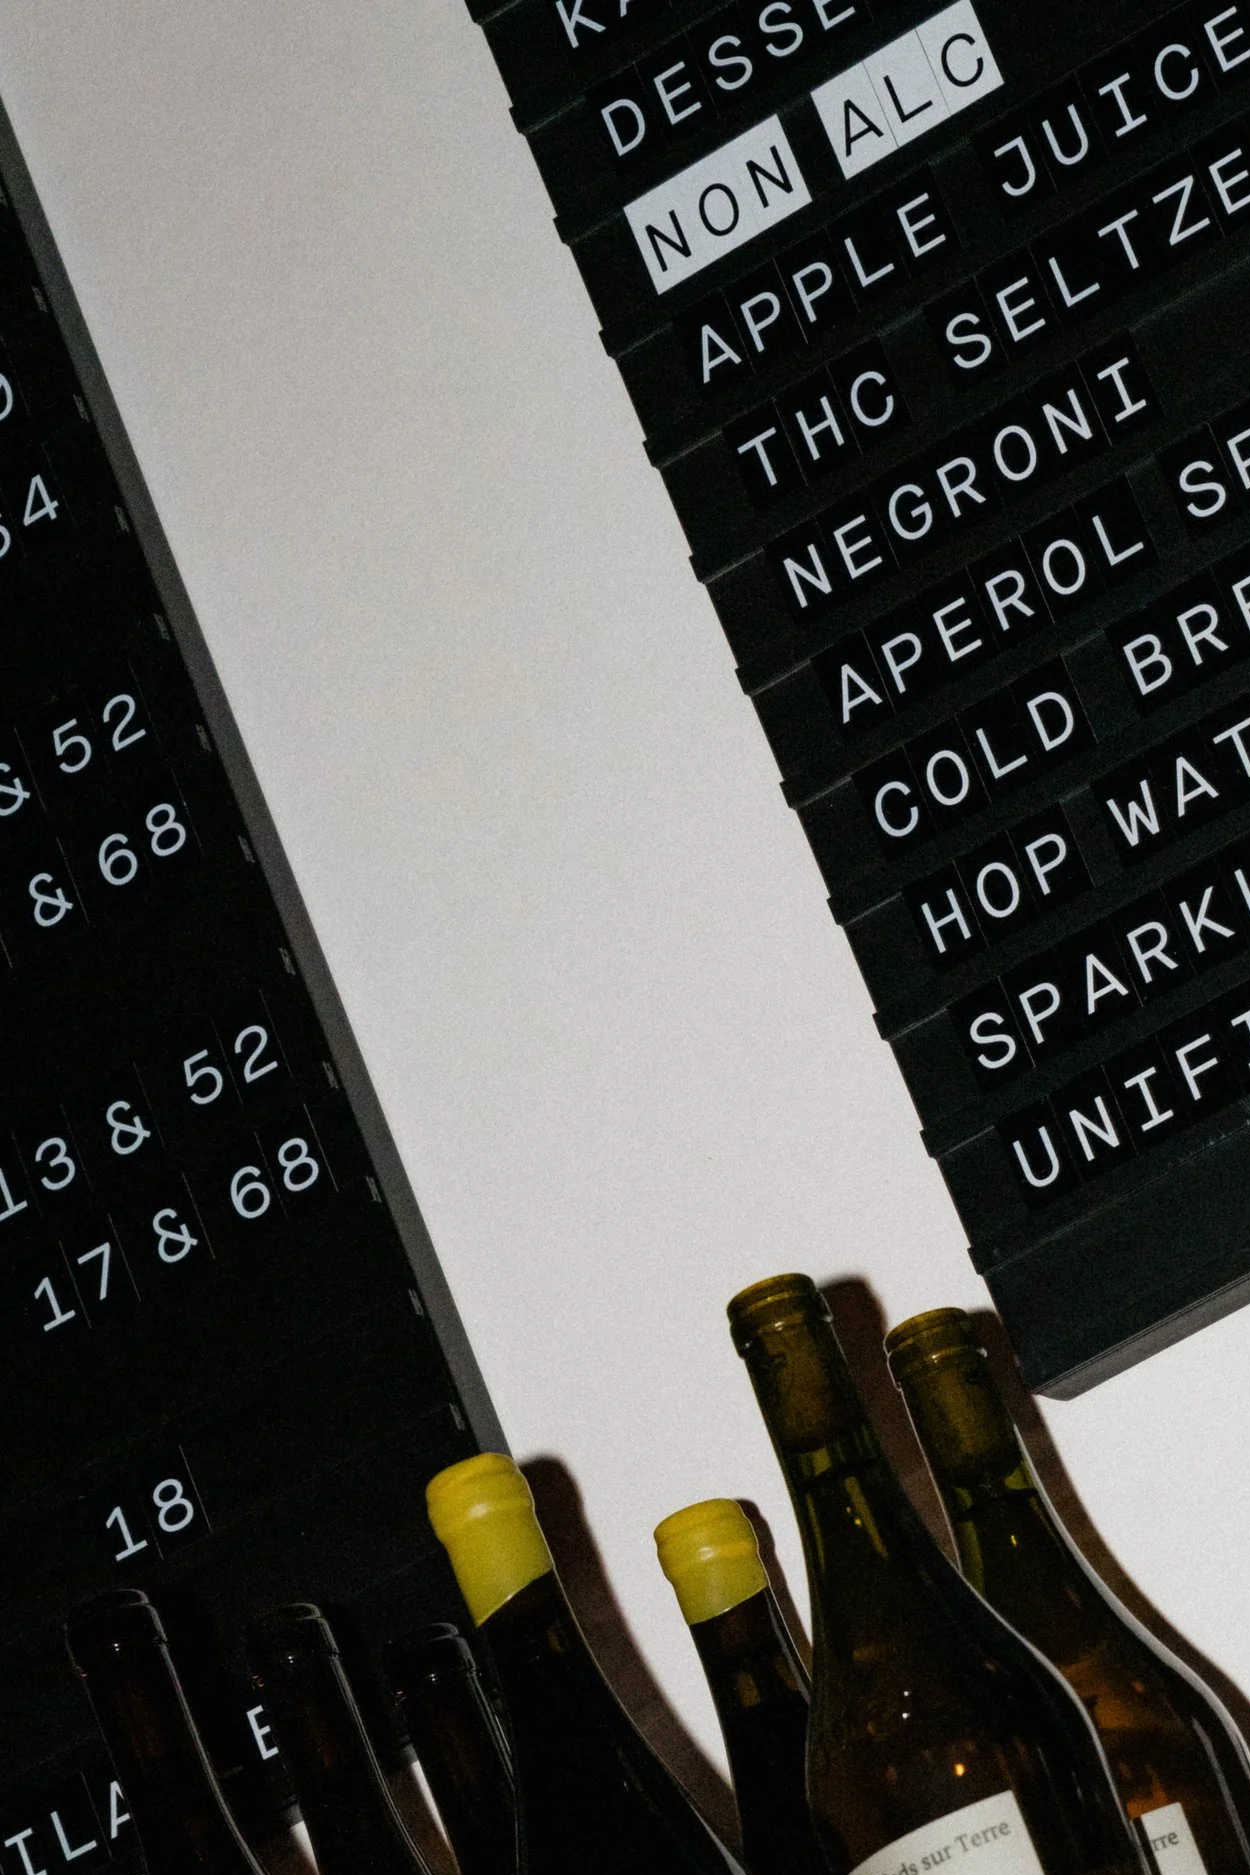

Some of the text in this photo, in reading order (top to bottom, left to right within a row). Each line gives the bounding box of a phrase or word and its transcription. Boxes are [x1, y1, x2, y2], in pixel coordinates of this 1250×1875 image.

[644, 30, 985, 272] NON ALC
[701, 192, 948, 384] APPLE
[737, 370, 895, 487] THC
[783, 356, 1148, 608] NEGRONI
[840, 514, 1145, 724] APEROL
[53, 693, 147, 773] 52
[874, 690, 1075, 838] COLD
[29, 802, 187, 928] & 68
[920, 832, 1068, 954] HOP
[0, 1024, 279, 1221] 13 & 52
[33, 1136, 320, 1332] 17 & 68
[105, 1477, 195, 1562] 18
[921, 1845, 953, 1871] sur
[954, 1820, 1012, 1853] Terre
